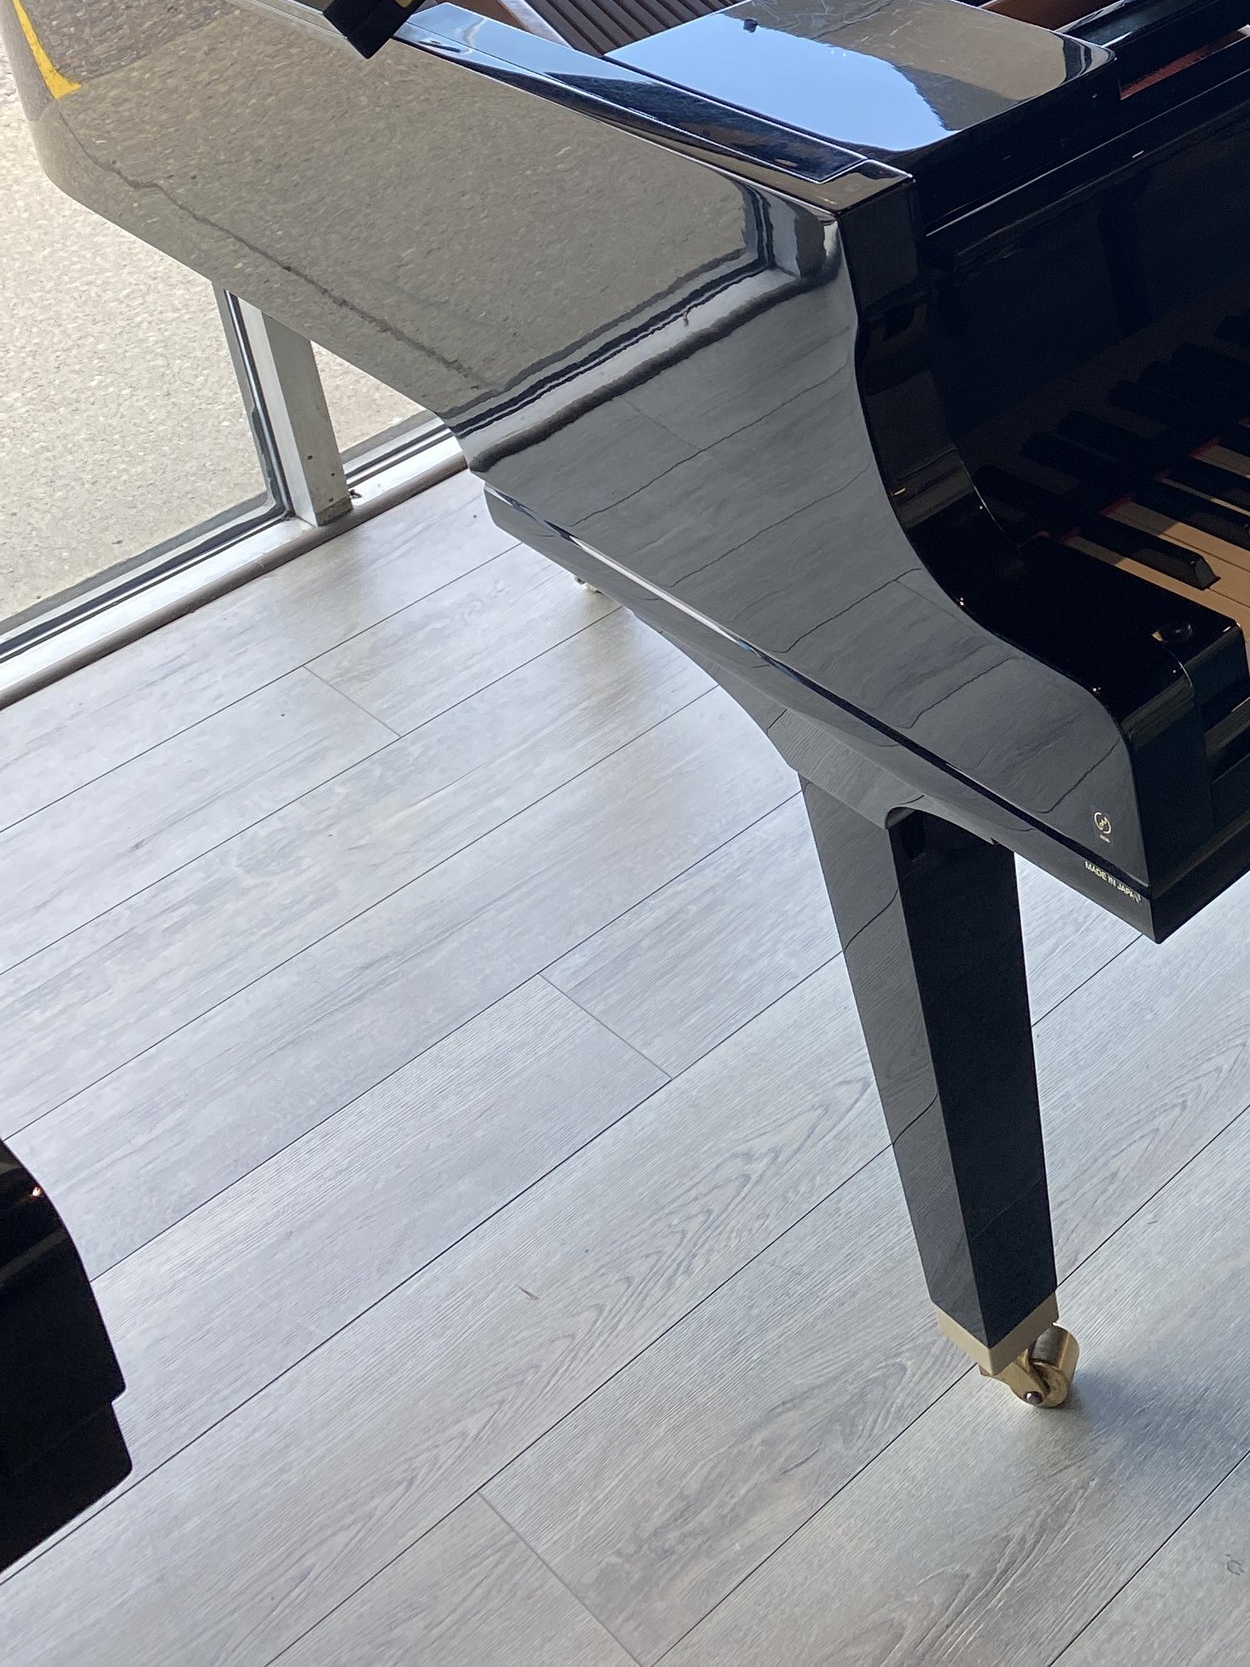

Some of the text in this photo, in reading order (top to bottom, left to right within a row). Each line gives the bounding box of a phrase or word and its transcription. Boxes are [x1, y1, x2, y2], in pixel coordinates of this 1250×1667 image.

[1084, 860, 1142, 903] MADE IN JAPAN
